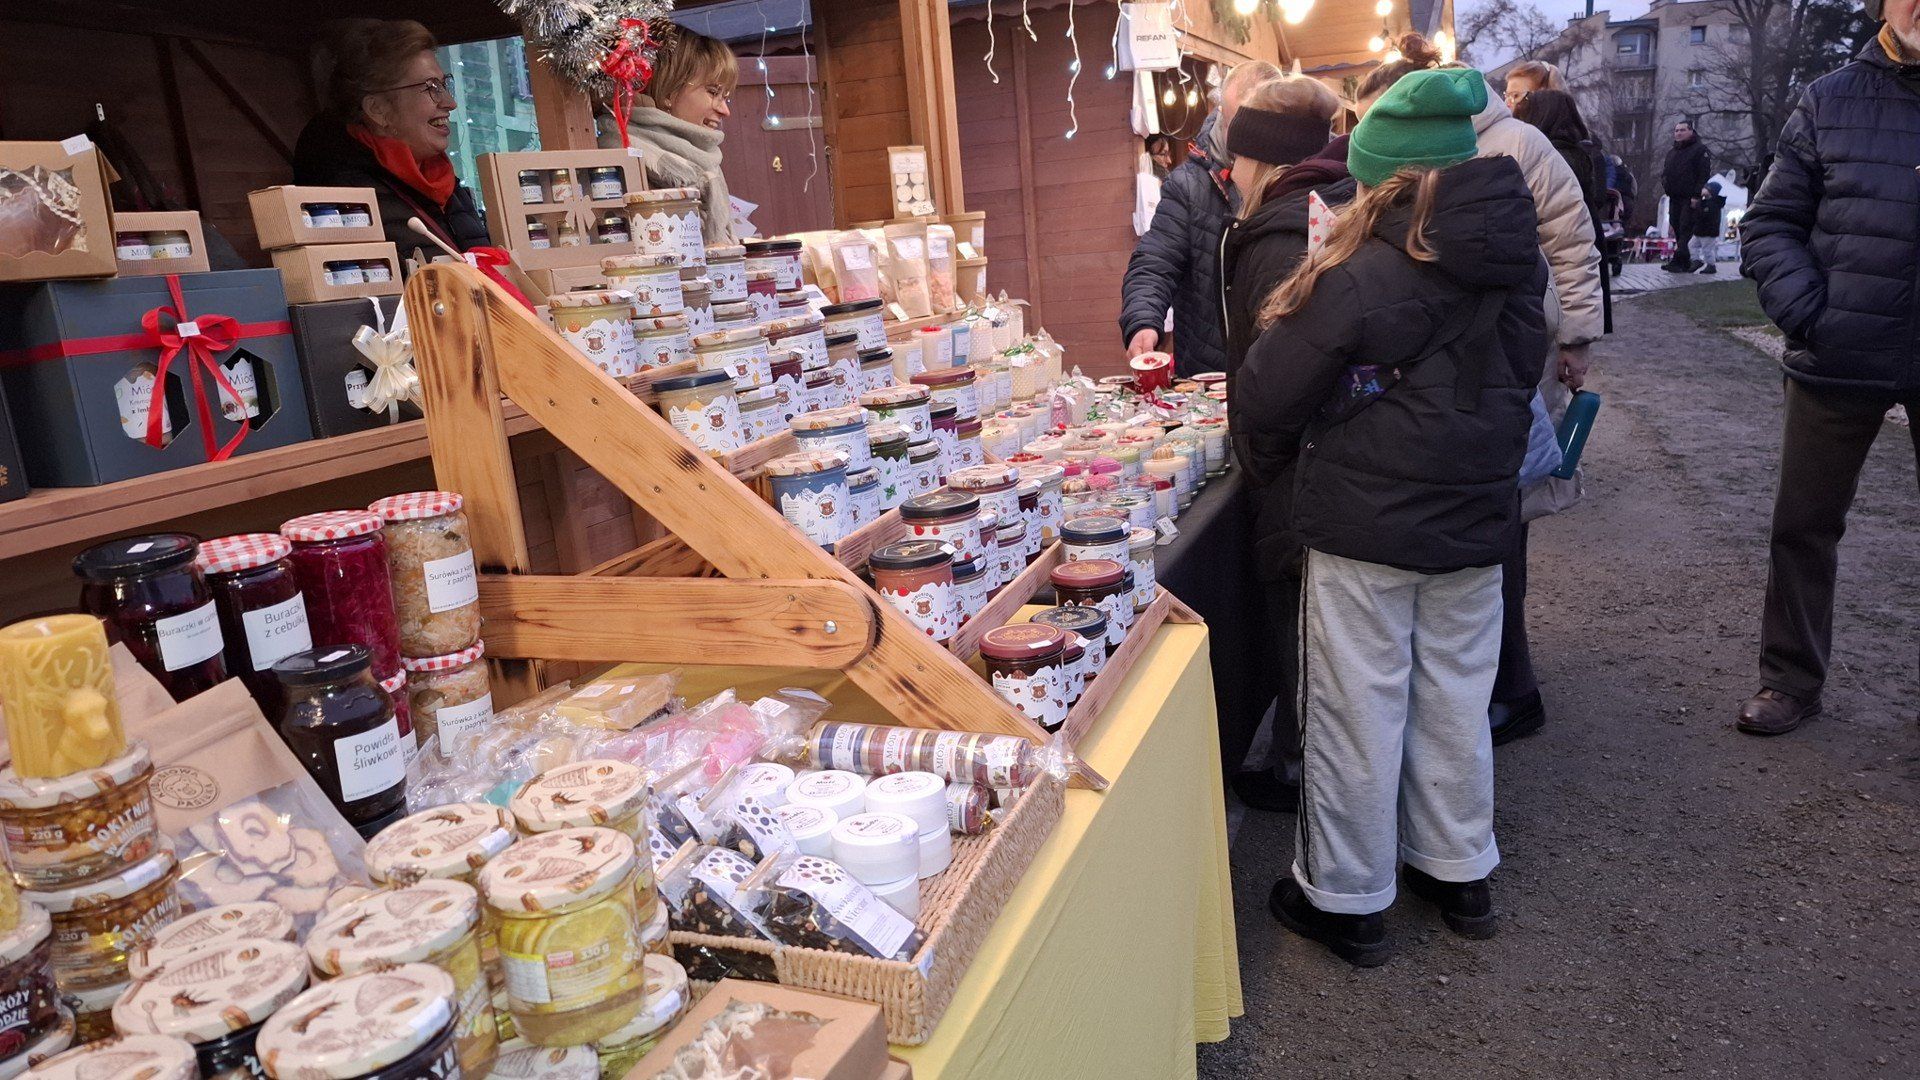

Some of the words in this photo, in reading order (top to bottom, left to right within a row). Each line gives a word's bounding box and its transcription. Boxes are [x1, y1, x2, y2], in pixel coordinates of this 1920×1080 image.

[772, 156, 782, 171] 4
[428, 569, 459, 581] Surówka
[911, 592, 935, 603] KUBUSIOWA
[915, 611, 934, 619] PASIEKA
[158, 621, 197, 638] Buraczki
[265, 629, 271, 638] z
[441, 715, 473, 727] Surówka
[354, 733, 394, 756] Powidła
[30, 831, 51, 840] 220
[54, 830, 64, 840] g
[58, 933, 78, 942] 220
[81, 931, 90, 942] g
